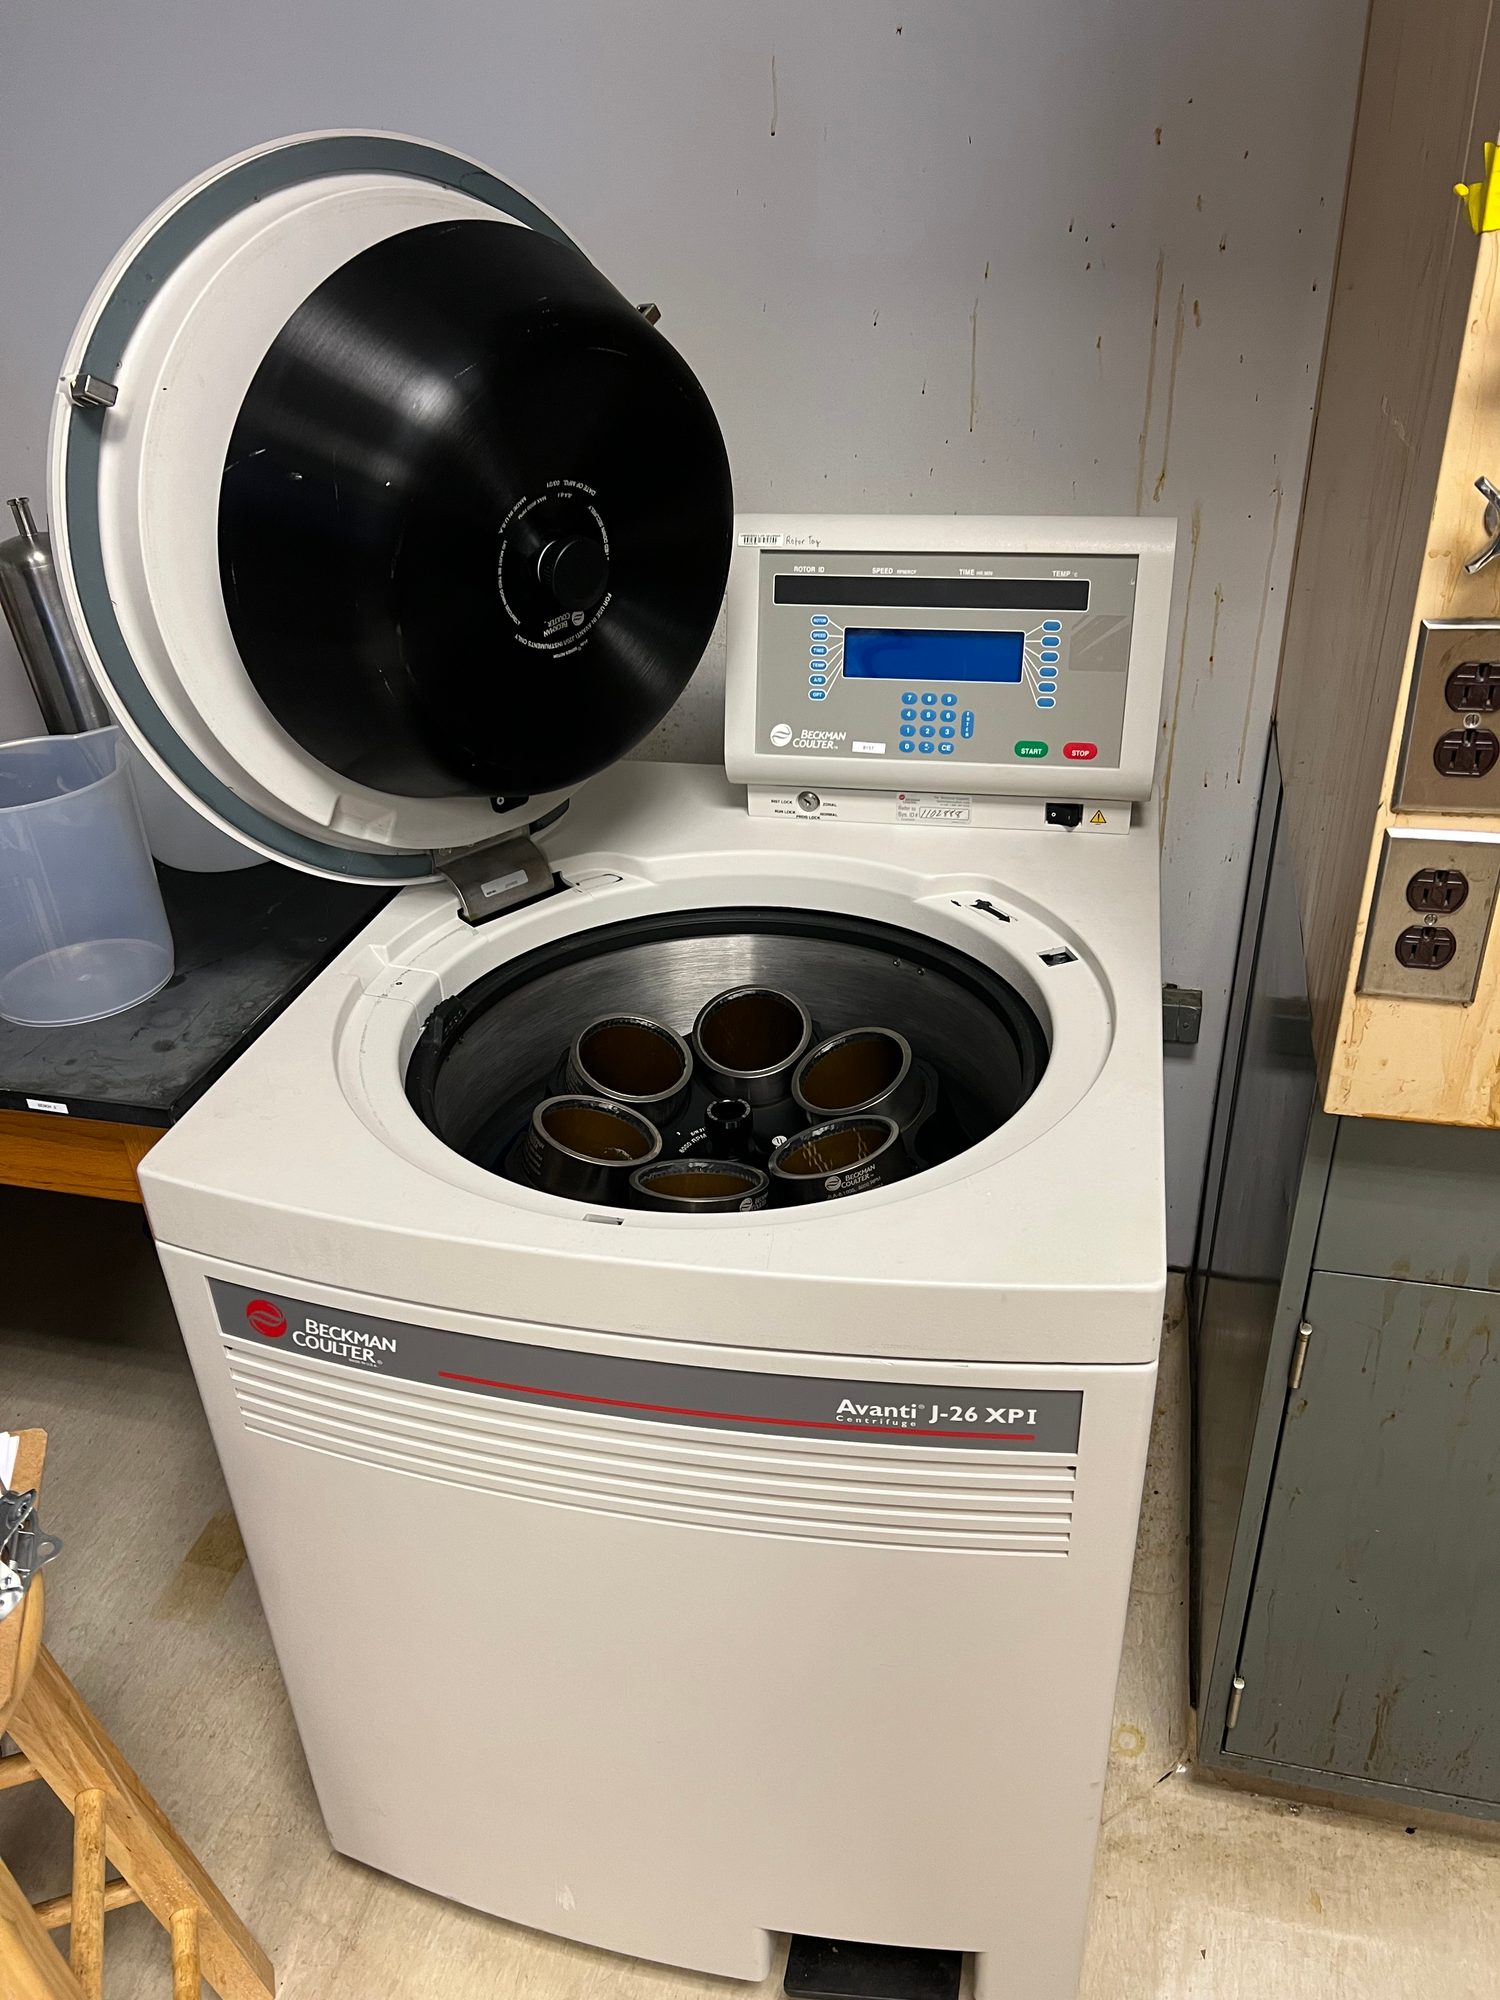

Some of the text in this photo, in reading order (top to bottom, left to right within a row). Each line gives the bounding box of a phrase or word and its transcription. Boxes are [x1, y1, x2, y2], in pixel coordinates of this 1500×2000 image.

[513, 496, 527, 512] MADE
[785, 535, 805, 546] Rotor
[872, 567, 894, 575] SPEED
[959, 568, 975, 576] TIME
[595, 605, 606, 619] USE
[543, 620, 568, 638] BECKMAN
[574, 622, 592, 639] AVANTI
[514, 634, 528, 645] ONLY
[528, 640, 563, 650] INSTRUMENTS
[800, 729, 847, 741] BECKMAN
[691, 1133, 708, 1144] RPM
[844, 1164, 876, 1182] BECKMAN
[305, 1317, 397, 1353] BECKMAN
[835, 1414, 917, 1428] Centrifuge
[929, 1404, 978, 1425] J-26
[984, 1407, 1037, 1425] XPI
